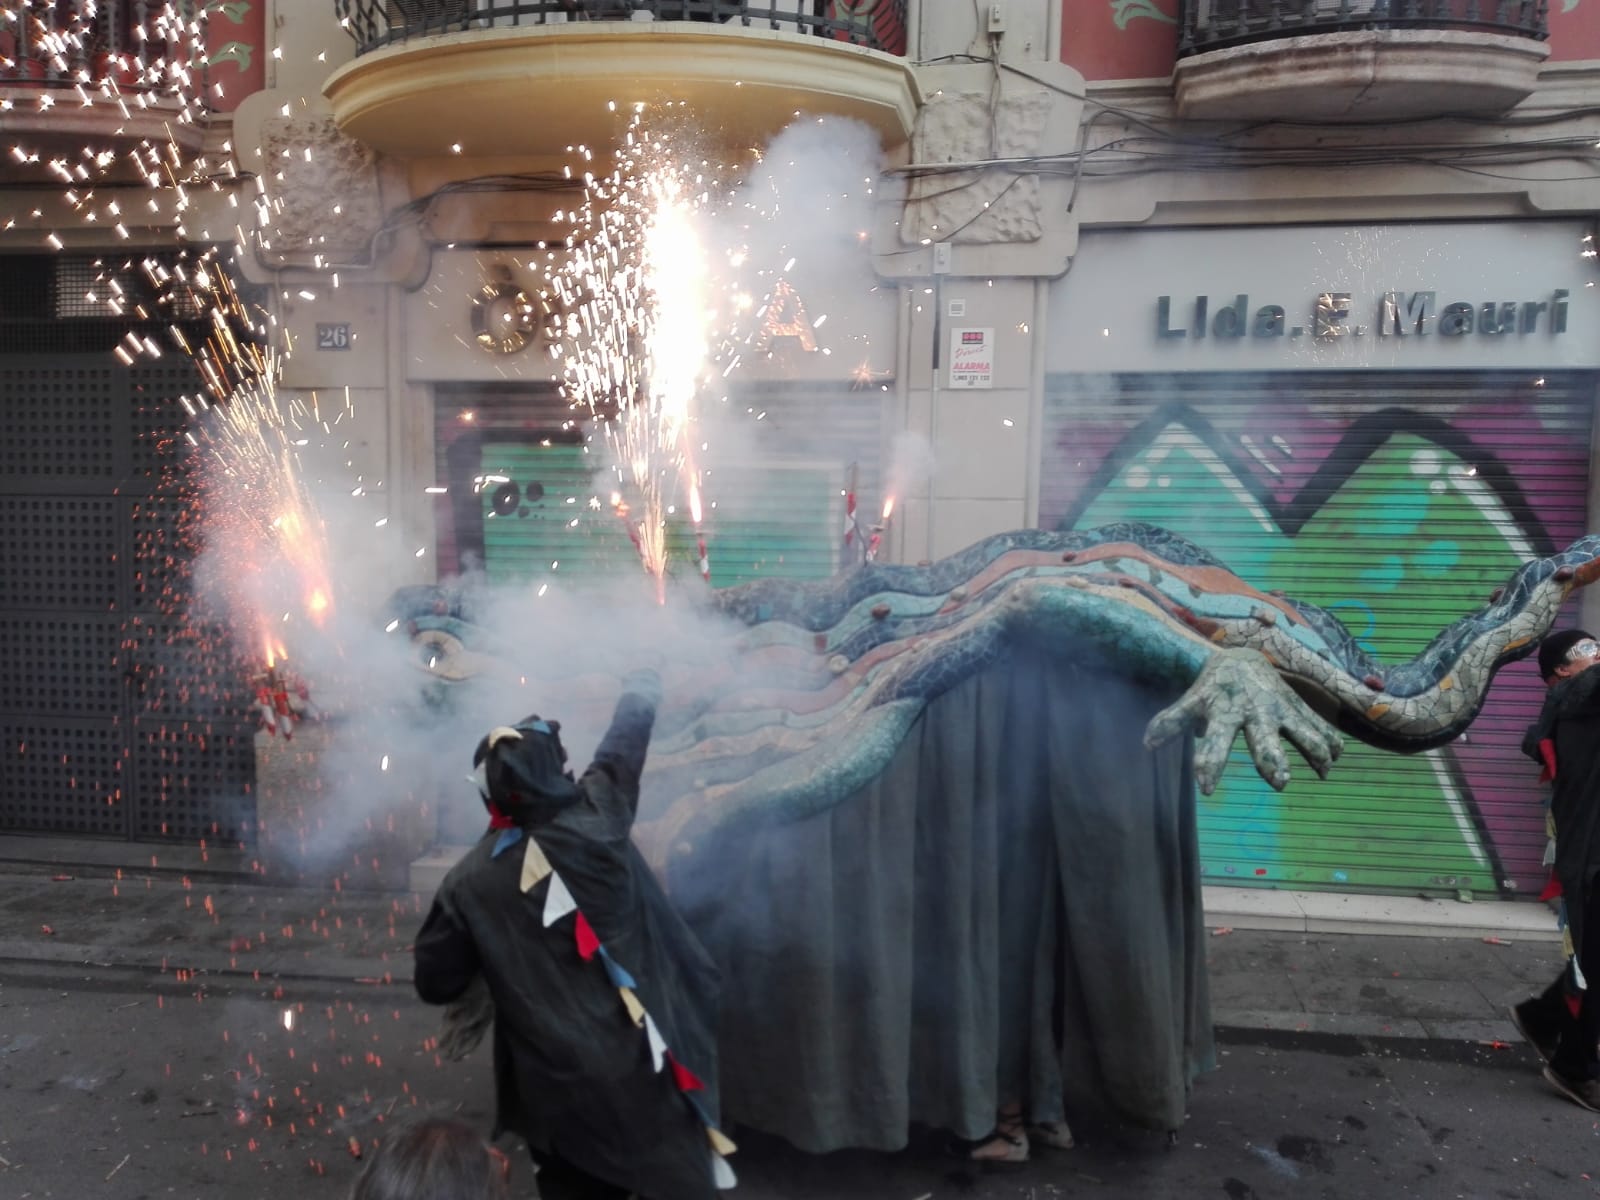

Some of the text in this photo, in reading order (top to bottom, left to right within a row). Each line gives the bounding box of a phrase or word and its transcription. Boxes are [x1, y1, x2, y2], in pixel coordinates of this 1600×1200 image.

[1317, 291, 1368, 337] E.
[1381, 287, 1570, 336] Mauri
[320, 326, 347, 347] 26
[952, 361, 991, 370] ALARMA
